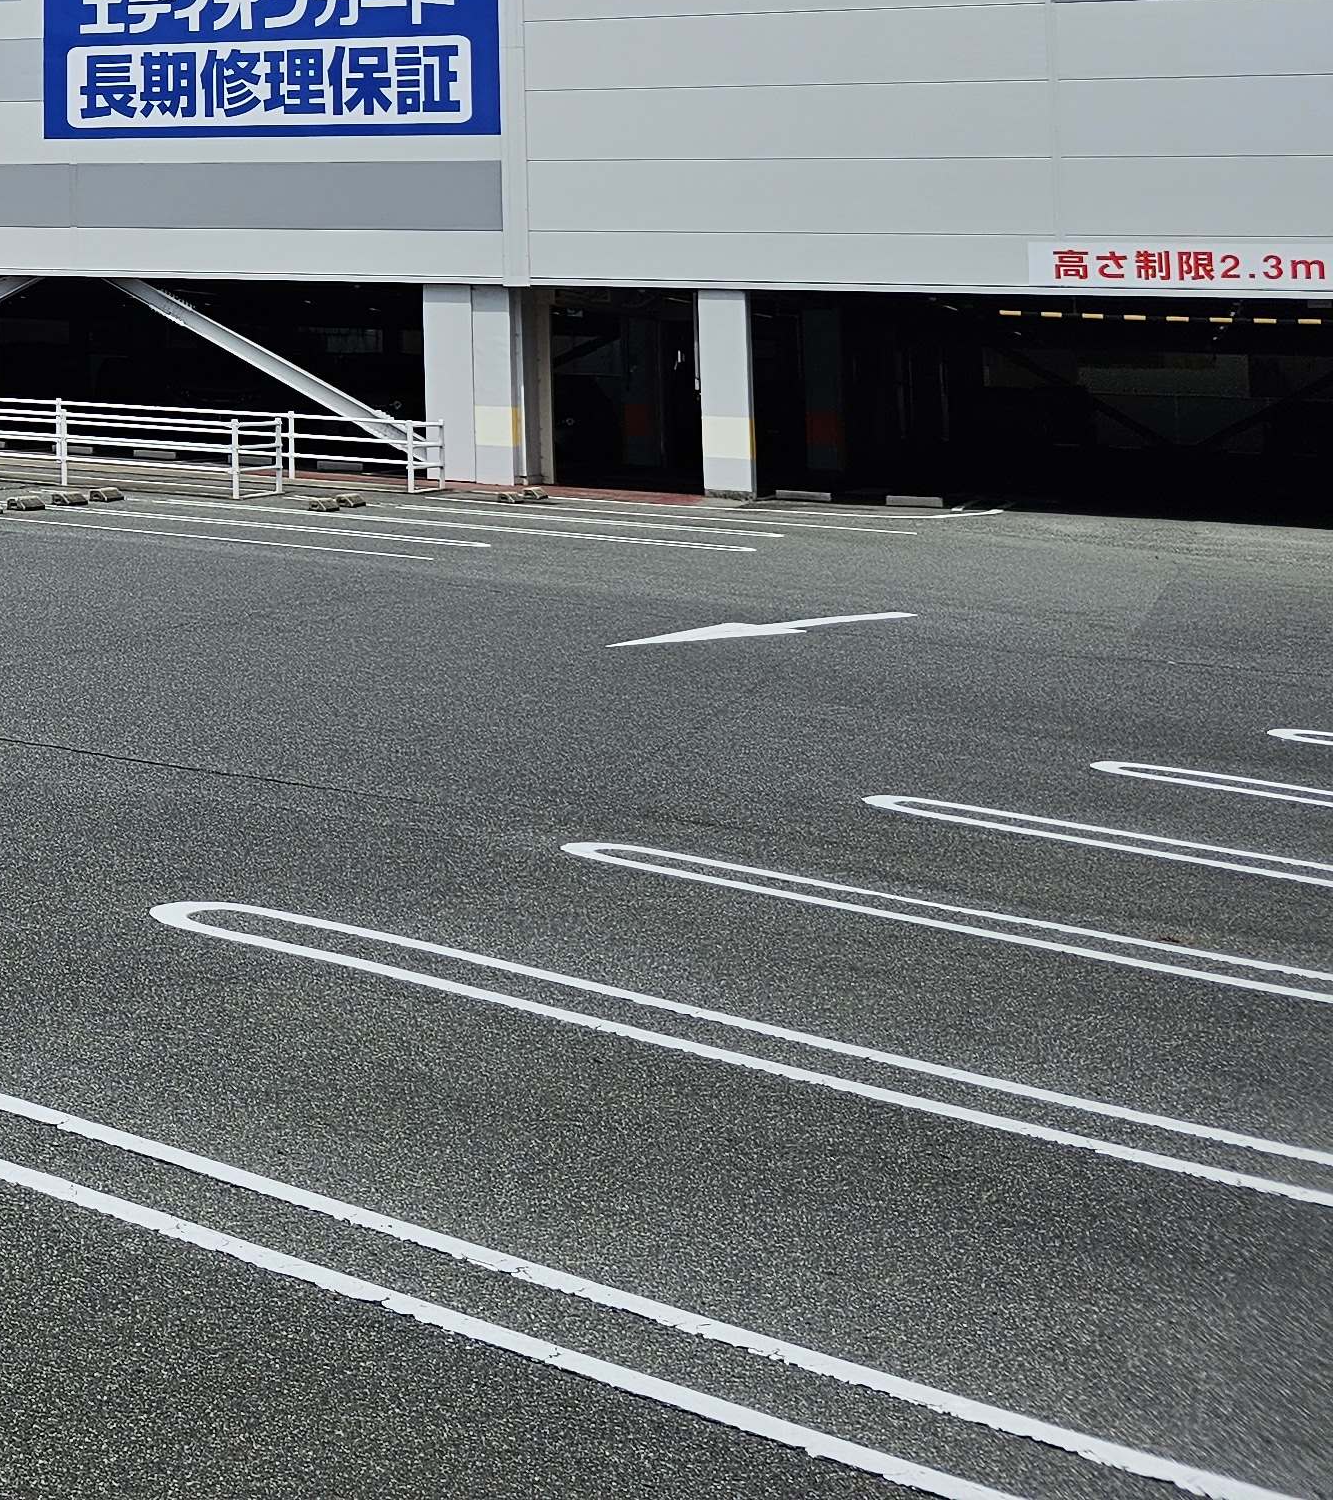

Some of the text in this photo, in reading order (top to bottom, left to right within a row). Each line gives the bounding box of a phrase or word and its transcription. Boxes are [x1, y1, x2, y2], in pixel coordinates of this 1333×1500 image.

[79, 45, 461, 120] 長期修理保証
[1052, 249, 1326, 281] 高さ制限2.3m
